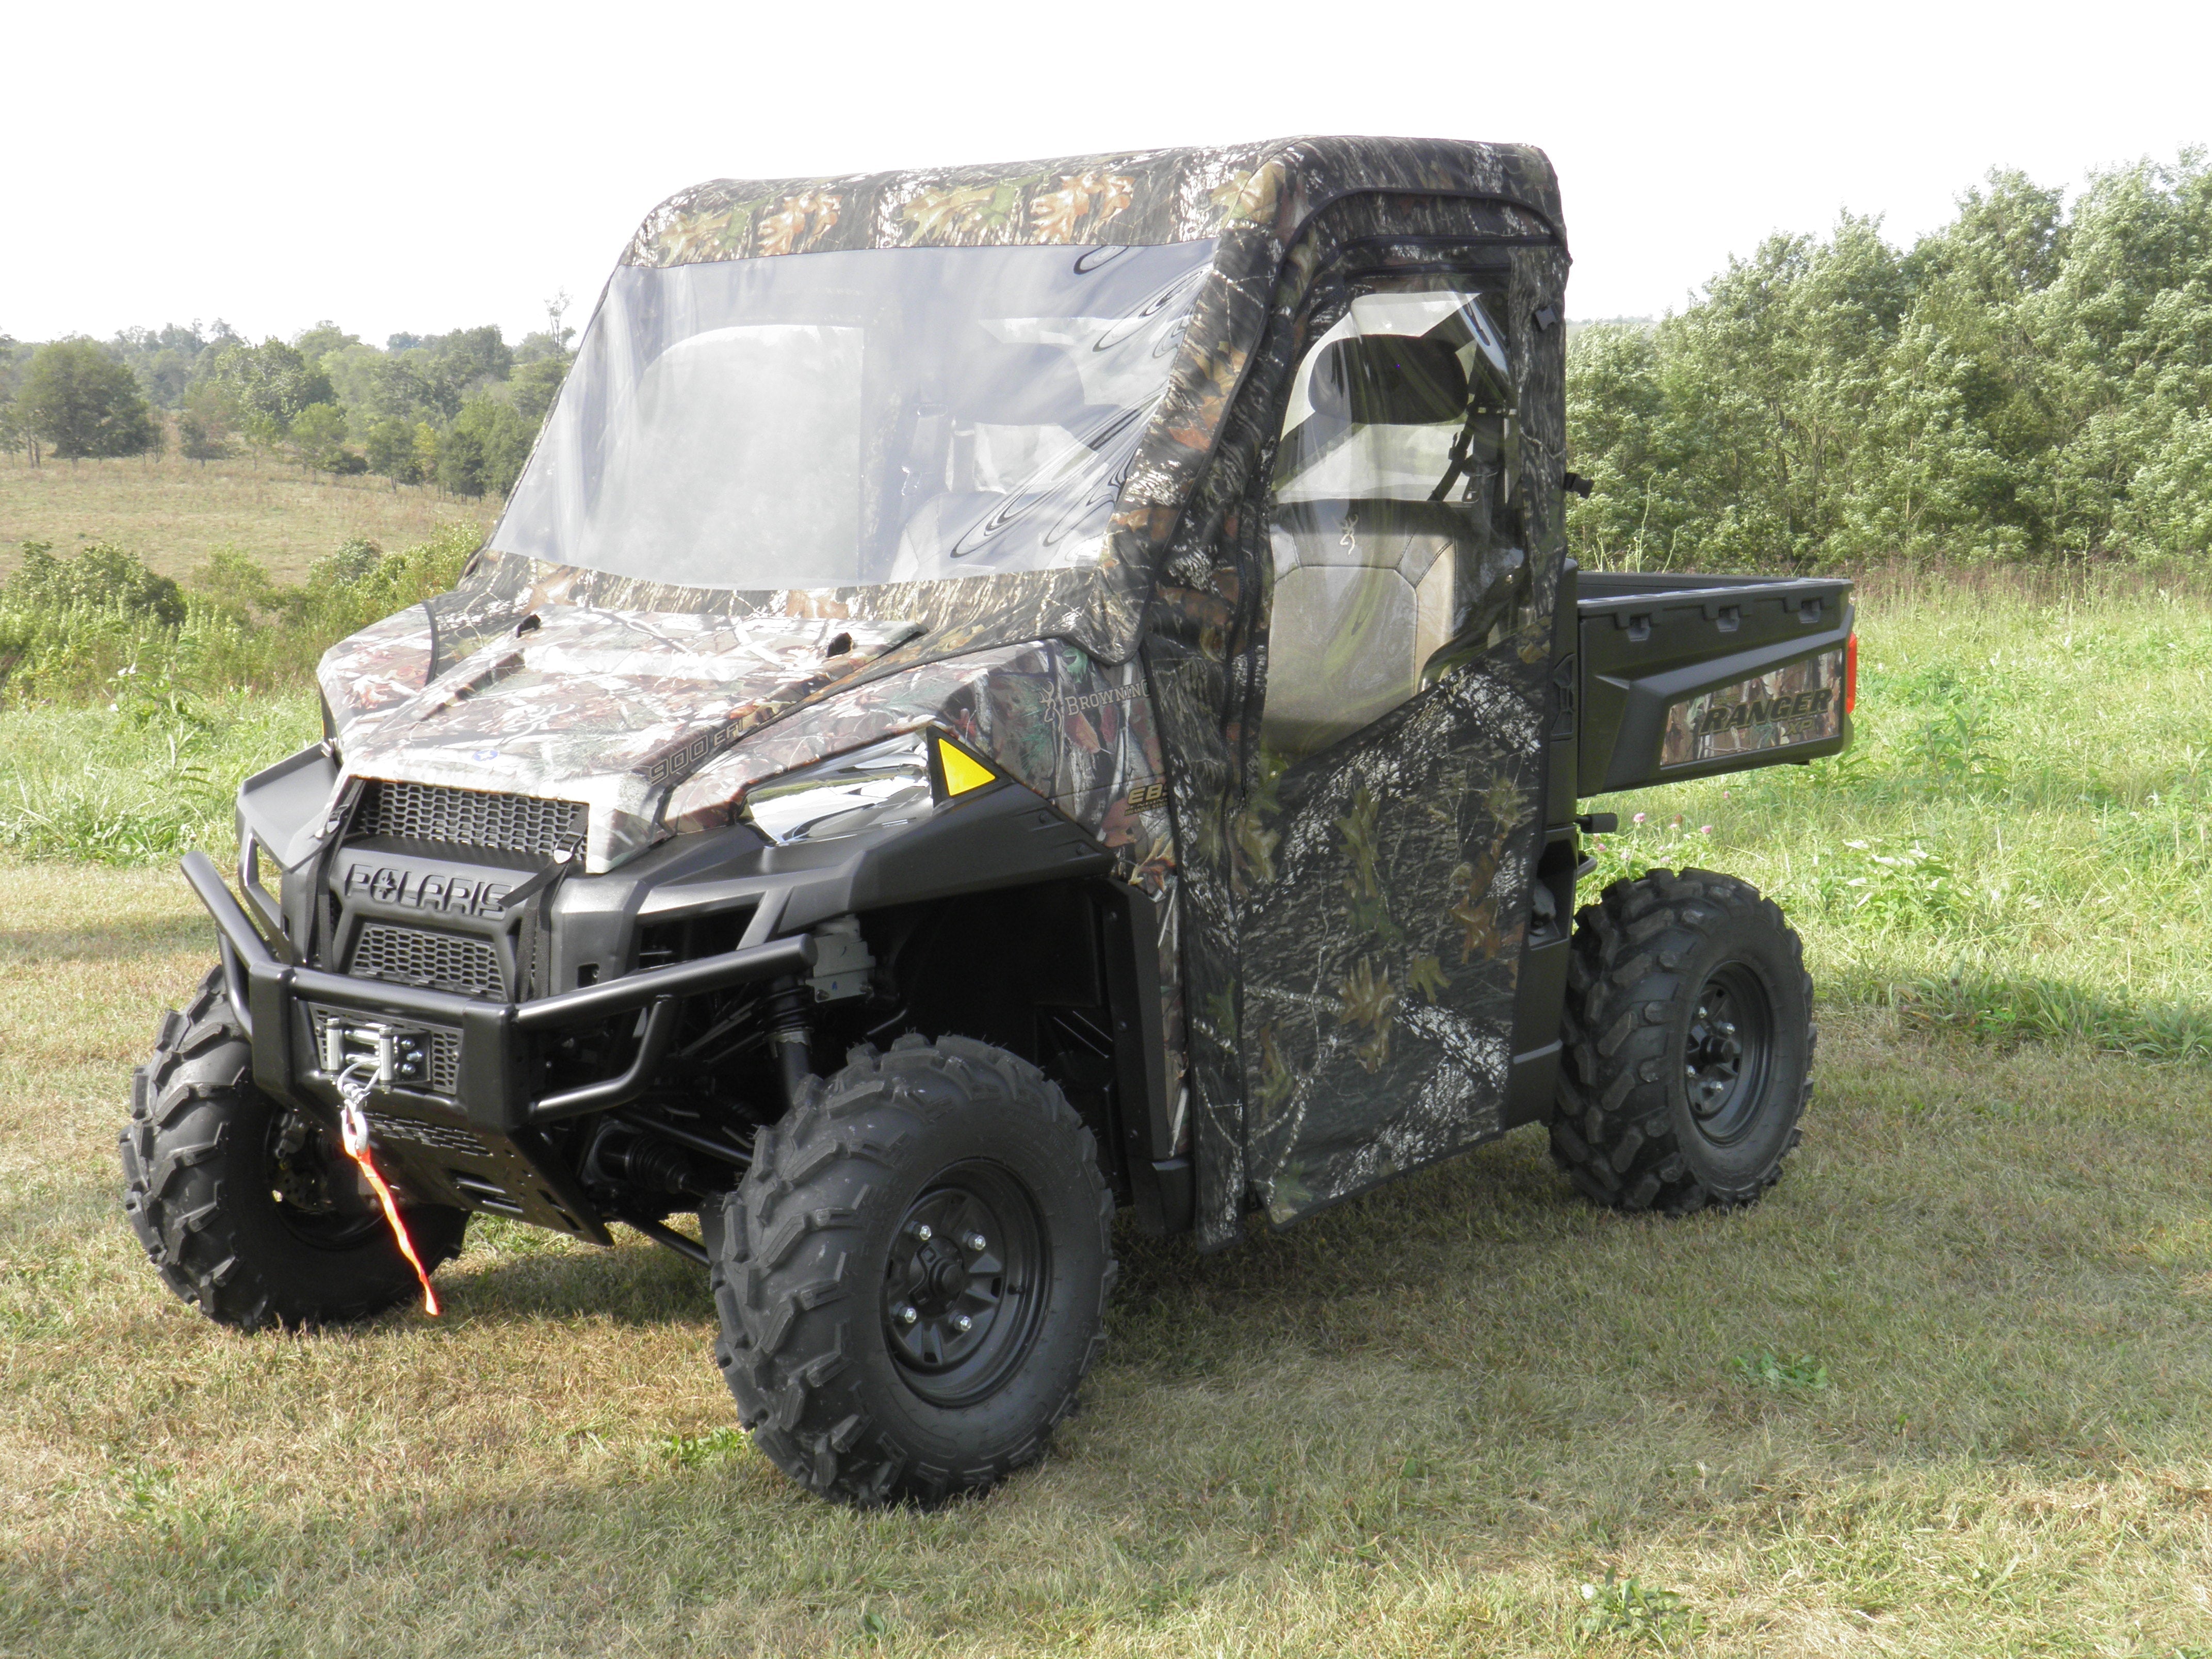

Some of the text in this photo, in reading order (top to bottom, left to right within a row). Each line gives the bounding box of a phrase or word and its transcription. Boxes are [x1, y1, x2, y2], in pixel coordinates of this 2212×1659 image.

[1699, 688, 1834, 736] RANGER
[1784, 718, 1815, 736] XP
[650, 718, 743, 786] 900 EFI
[1127, 783, 1168, 805] EB
[345, 864, 514, 921] POLARIS
